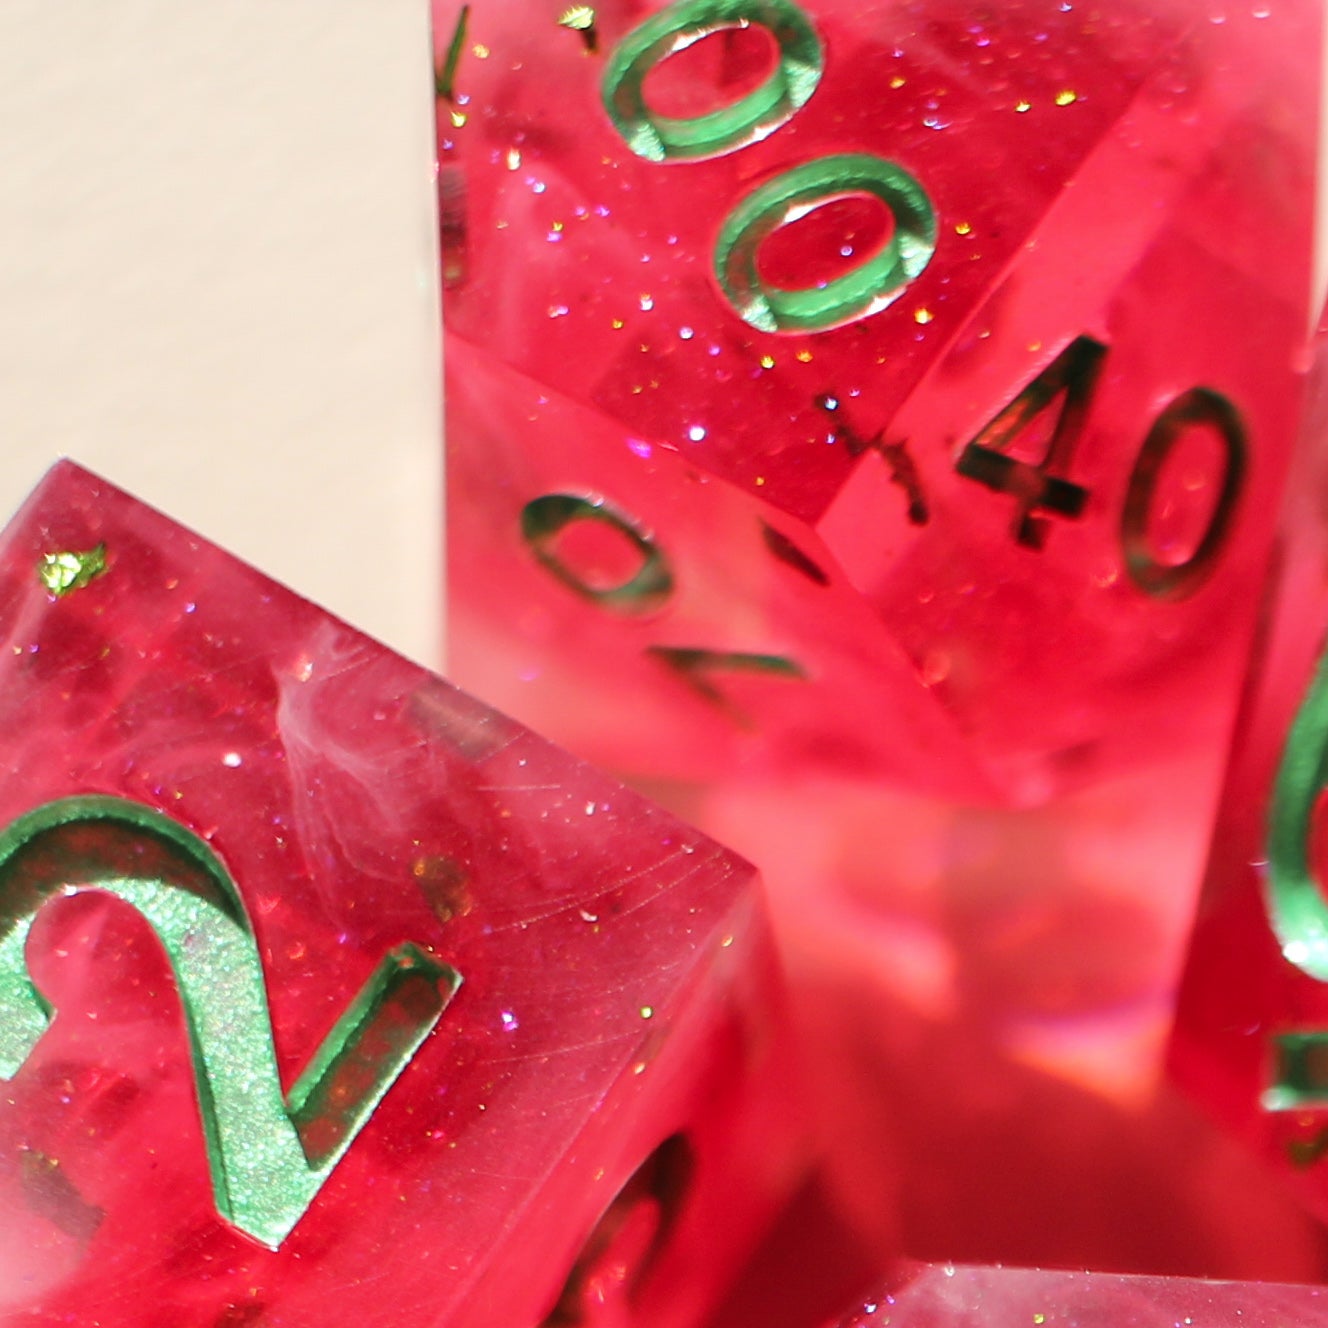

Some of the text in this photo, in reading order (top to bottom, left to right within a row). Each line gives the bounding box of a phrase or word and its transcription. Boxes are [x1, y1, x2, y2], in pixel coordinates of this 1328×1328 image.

[600, 0, 938, 336] 00
[955, 334, 1250, 600] 40
[0, 794, 463, 1253] 2
